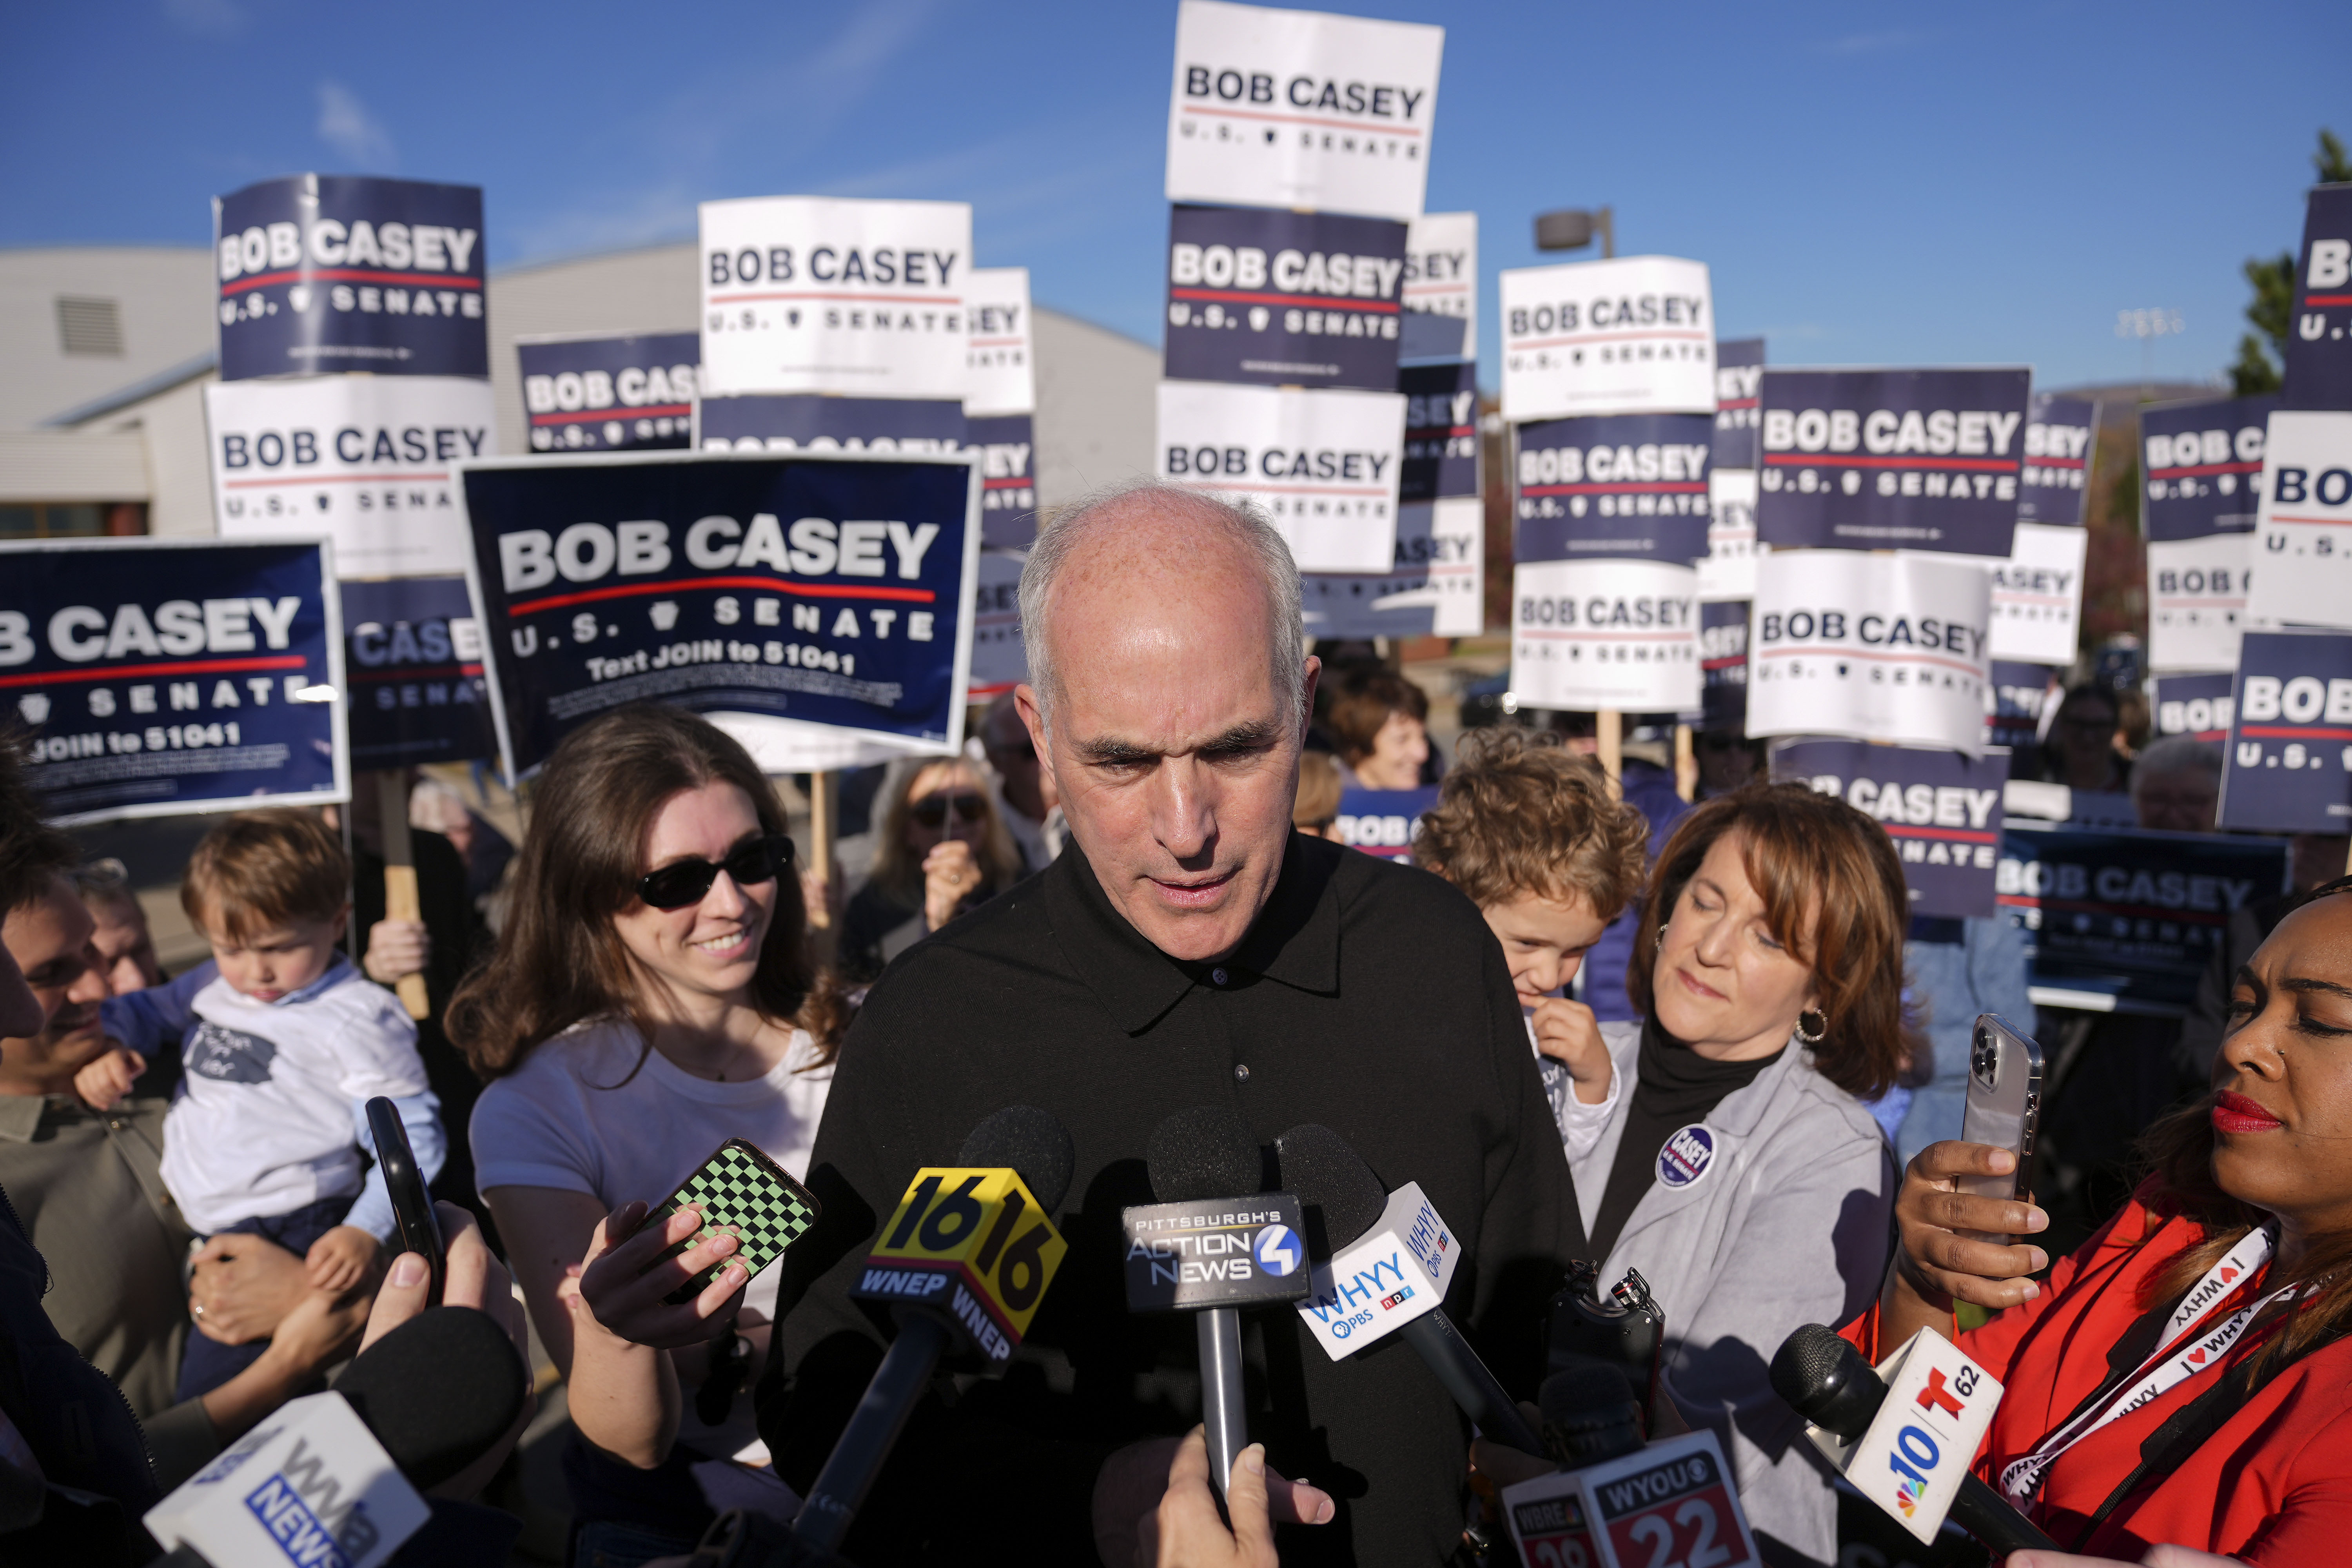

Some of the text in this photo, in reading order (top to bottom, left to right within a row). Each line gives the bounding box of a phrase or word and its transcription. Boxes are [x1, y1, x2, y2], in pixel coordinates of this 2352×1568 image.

[1186, 66, 1424, 119] BOB CASEY
[1181, 121, 1419, 160] U.S. SENATE
[220, 220, 477, 280] BOB CASEY
[710, 247, 956, 285] BOB CASEY
[1404, 251, 1465, 279] SEY
[1172, 243, 1404, 299] BOB CASEY
[220, 286, 482, 325] U.S. SENATE
[708, 312, 769, 331] U.S.
[826, 311, 960, 333] SENATE
[1169, 302, 1399, 340] U.S. SENATE
[1510, 295, 1701, 335] BOB CASEY
[1602, 345, 1706, 362] SENATE
[526, 364, 695, 413] BOB CAS
[1409, 391, 1474, 428] SEY
[223, 428, 487, 468] BOB CASEY
[1763, 408, 2022, 456] BOB CASEY
[2024, 423, 2089, 459] SEY
[2146, 429, 2231, 468] BOB
[1167, 446, 1389, 480] BOB CASEY
[1519, 443, 1708, 485] BOB CASEY
[2021, 465, 2084, 490] NATE
[225, 490, 451, 517] U.S. SENA
[1761, 468, 2016, 501] U.S. SENATE
[2275, 467, 2352, 506] BO
[1274, 501, 1388, 517] SENATE
[1598, 494, 1710, 517] SENATE
[498, 513, 940, 593] BOB CASEY
[1395, 534, 1471, 563] ASEY
[2267, 534, 2351, 558] U.S.
[1992, 570, 2071, 590] ASEY
[2159, 570, 2230, 593] BOB
[47, 596, 302, 662] CASEY
[511, 612, 619, 658] U.S.
[714, 596, 935, 642] SENATE
[1521, 597, 1694, 624] BOB CASEY
[354, 617, 481, 666] CASE
[1597, 644, 1693, 663] SENATE
[1762, 611, 1987, 659] BOB CASEY
[586, 640, 855, 682] Text JOIN to 51041
[88, 675, 309, 718] SENATE
[375, 679, 485, 710] SENA
[1871, 670, 1984, 701] SENATE
[2241, 675, 2352, 724] BOB
[35, 733, 104, 764] JOIN
[108, 728, 142, 754] to
[144, 722, 241, 751] 51041
[2237, 741, 2322, 769] U.S.
[1847, 777, 1998, 829] CASEY
[1894, 840, 1995, 869] NATE
[1996, 859, 2254, 911] BOB CASEY
[1671, 1129, 1711, 1169] CASEY
[885, 1176, 988, 1252] 16
[1136, 1211, 1281, 1231] PITTSBURGH'S
[1406, 1200, 1438, 1261] WHYY
[974, 1189, 1053, 1311] 16
[1127, 1232, 1251, 1262] ACTION
[1260, 1224, 1293, 1277] 4
[1432, 1232, 1448, 1269] PBS npr
[861, 1270, 947, 1296] WNEP
[1151, 1258, 1252, 1286] NEWS
[1304, 1252, 1405, 1323] WHYY
[1348, 1287, 1410, 1330] PBS npr
[2176, 1257, 2245, 1327] I WHYY
[951, 1283, 1010, 1360] WNEP
[1433, 1310, 1454, 1337] WHYY
[2181, 1307, 2252, 1374] I WHYY
[1955, 1365, 1980, 1397] 62
[1889, 1425, 1940, 1486] 10
[1607, 1465, 1688, 1511] WYOU
[251, 1479, 350, 1568] NEWS
[1517, 1501, 1564, 1530] WBRE
[1629, 1498, 1731, 1568] 22
